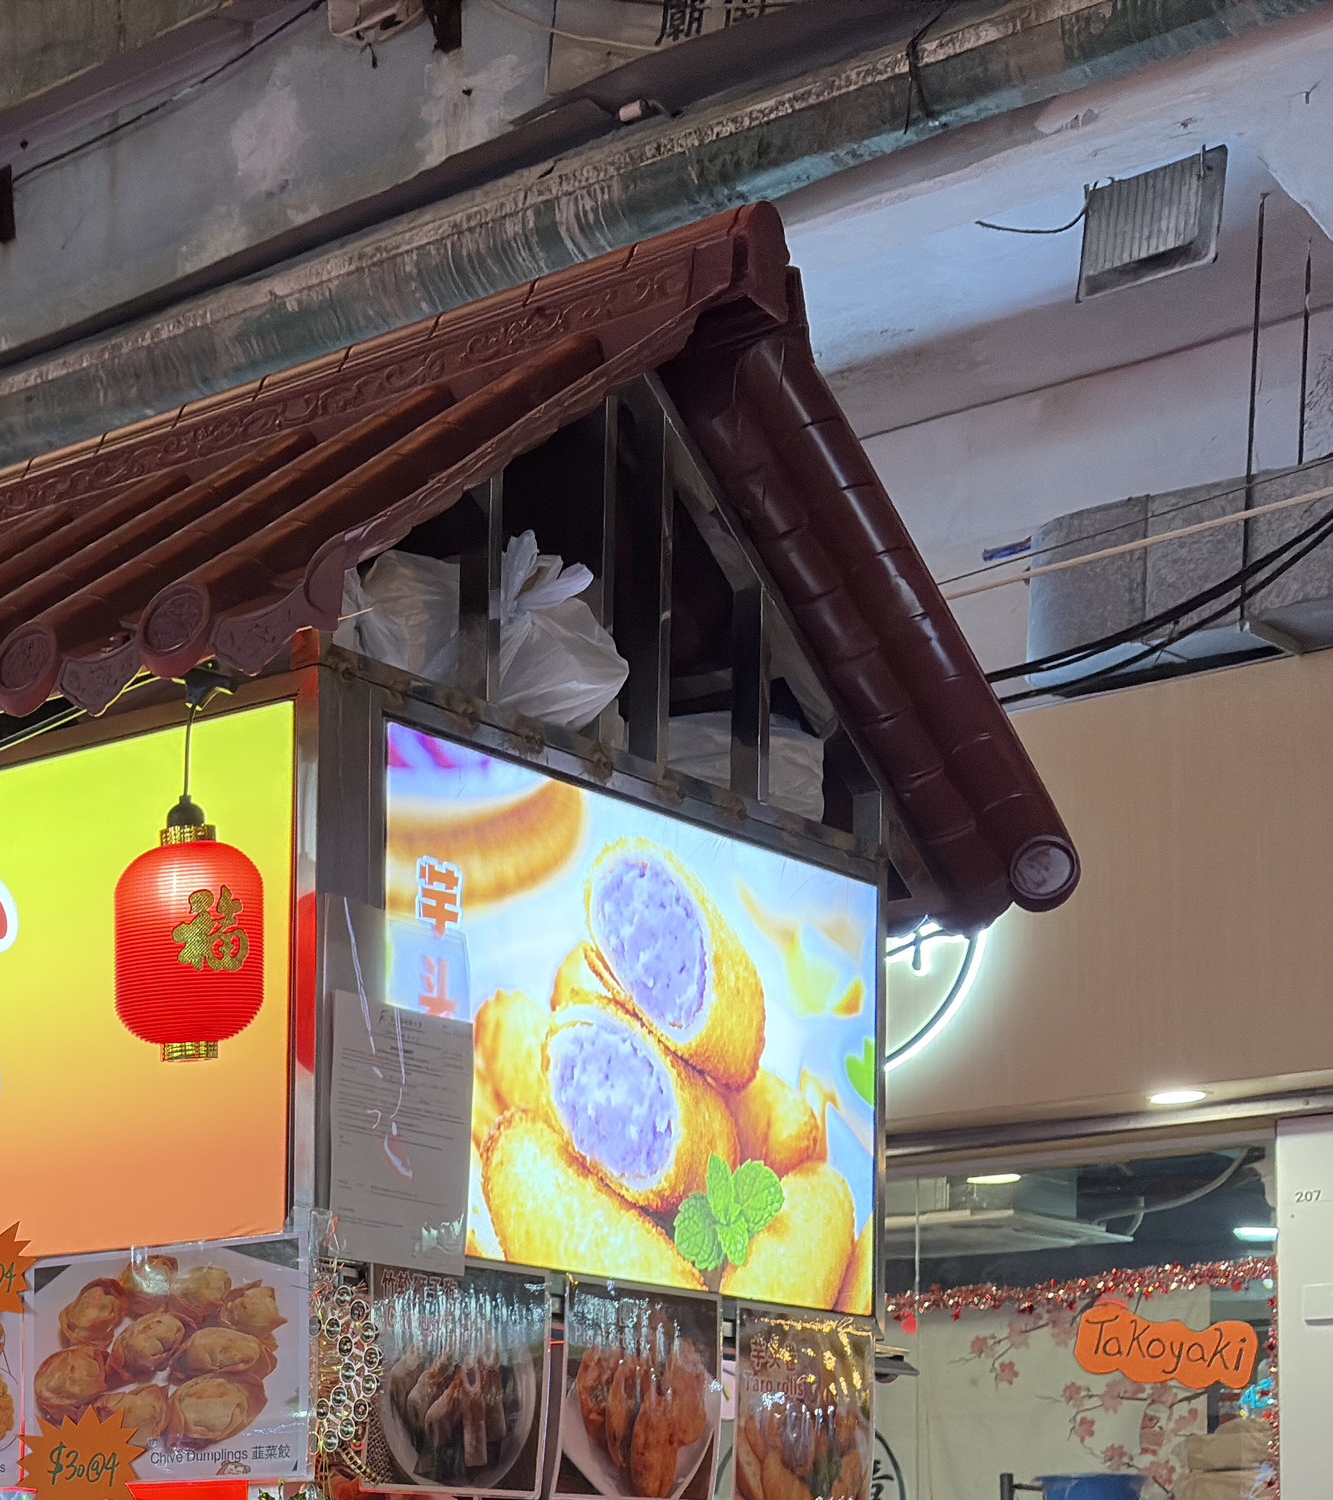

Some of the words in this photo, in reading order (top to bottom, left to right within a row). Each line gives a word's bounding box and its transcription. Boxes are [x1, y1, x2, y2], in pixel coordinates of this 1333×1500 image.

[1295, 1190, 1322, 1204] 207
[151, 1450, 183, 1465] Chive
[187, 1448, 248, 1465] Dumplings
